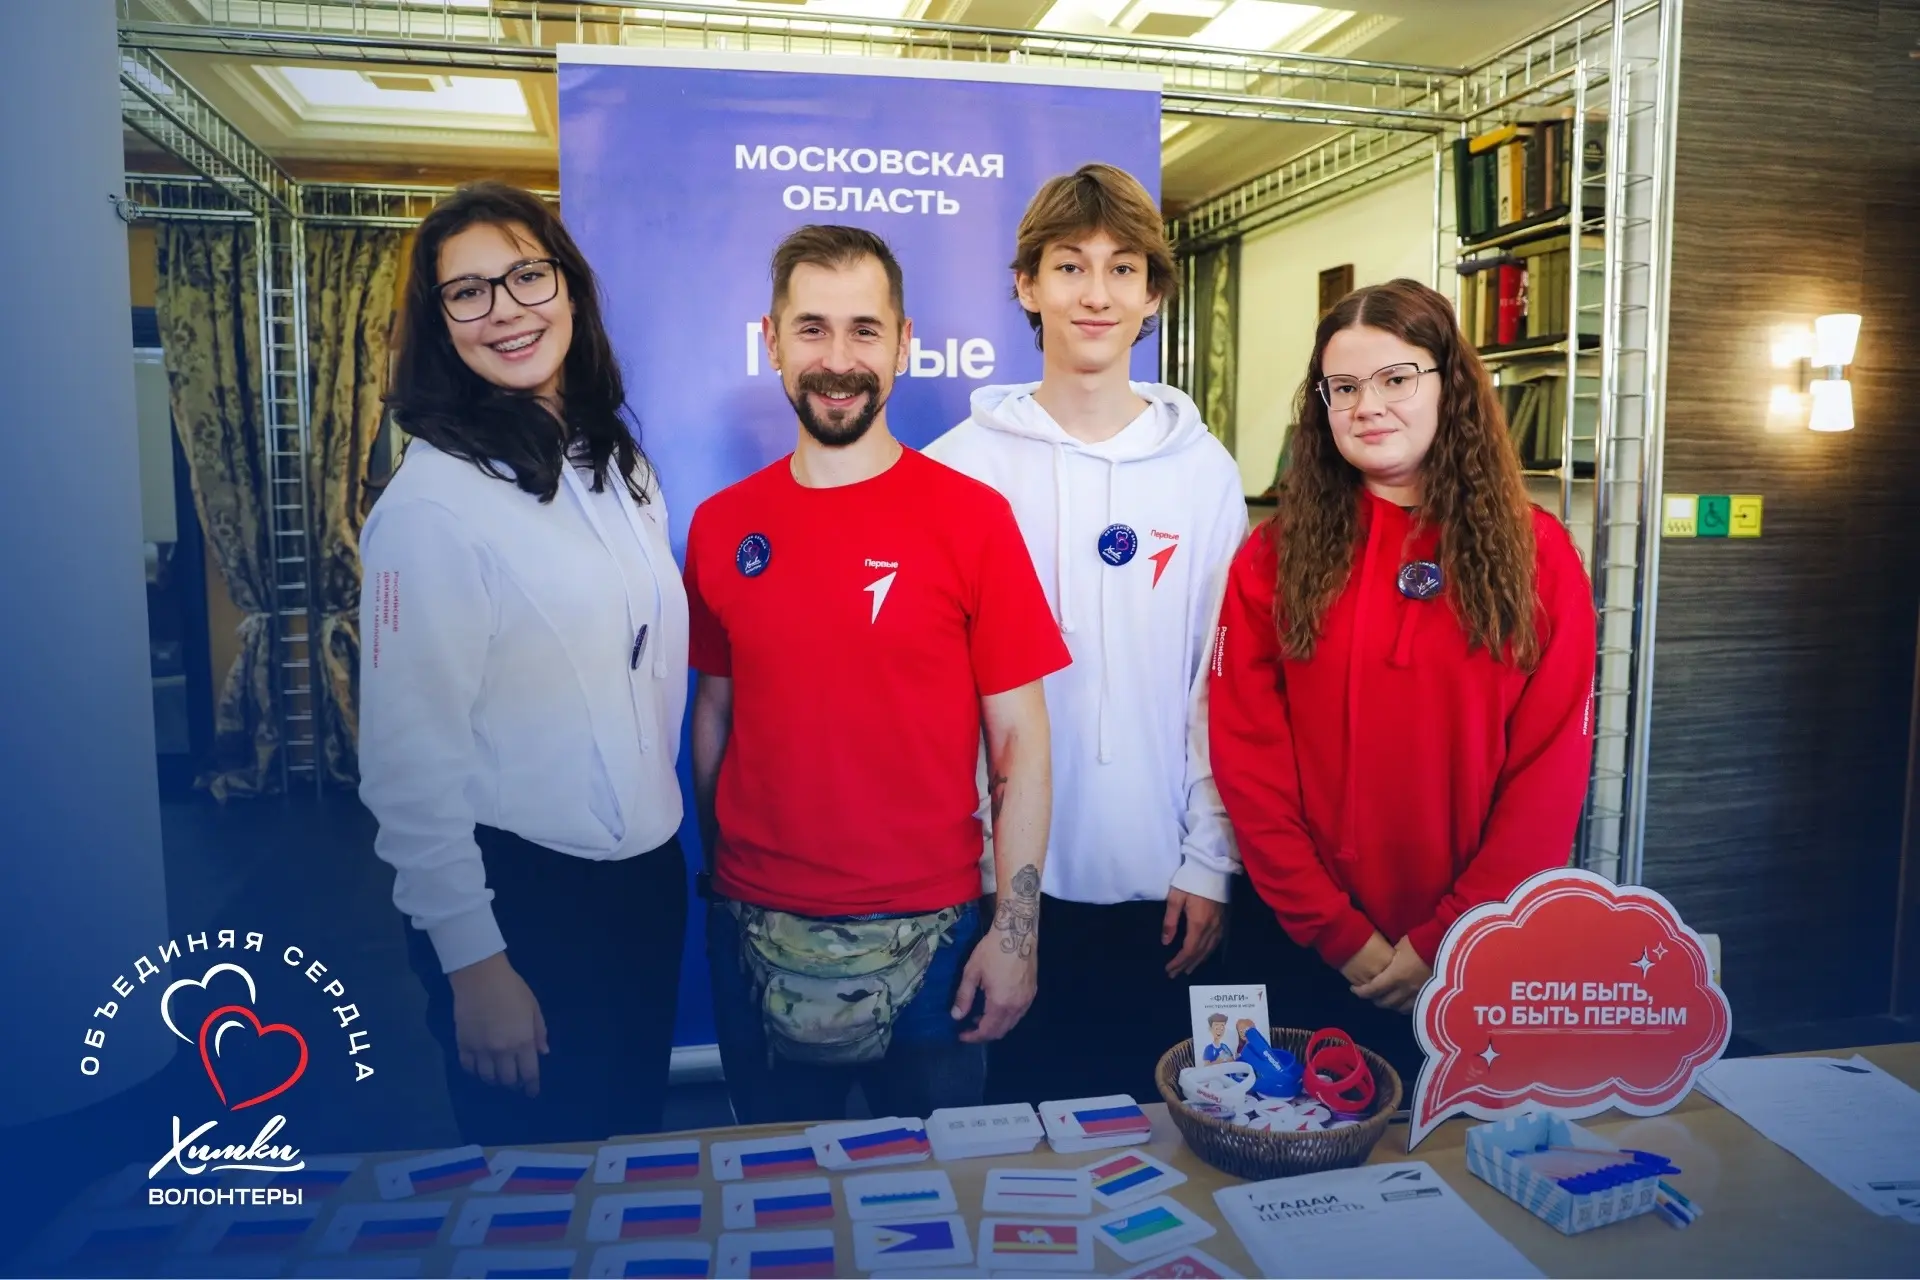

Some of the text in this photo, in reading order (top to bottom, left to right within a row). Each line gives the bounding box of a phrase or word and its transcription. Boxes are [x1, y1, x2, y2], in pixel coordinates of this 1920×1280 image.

[735, 144, 1004, 178] МОСКОВСКАЯ
[782, 185, 960, 215] ОБЛАСТЬ
[1151, 529, 1180, 540] Первые
[864, 558, 899, 569] Первые
[1511, 981, 1654, 1005] ЕСЛИ БЫТЬ,
[1474, 1005, 1687, 1025] ТО БЫТЬ ПЕРВЫМ
[1253, 1193, 1339, 1212] УГАДАЙ
